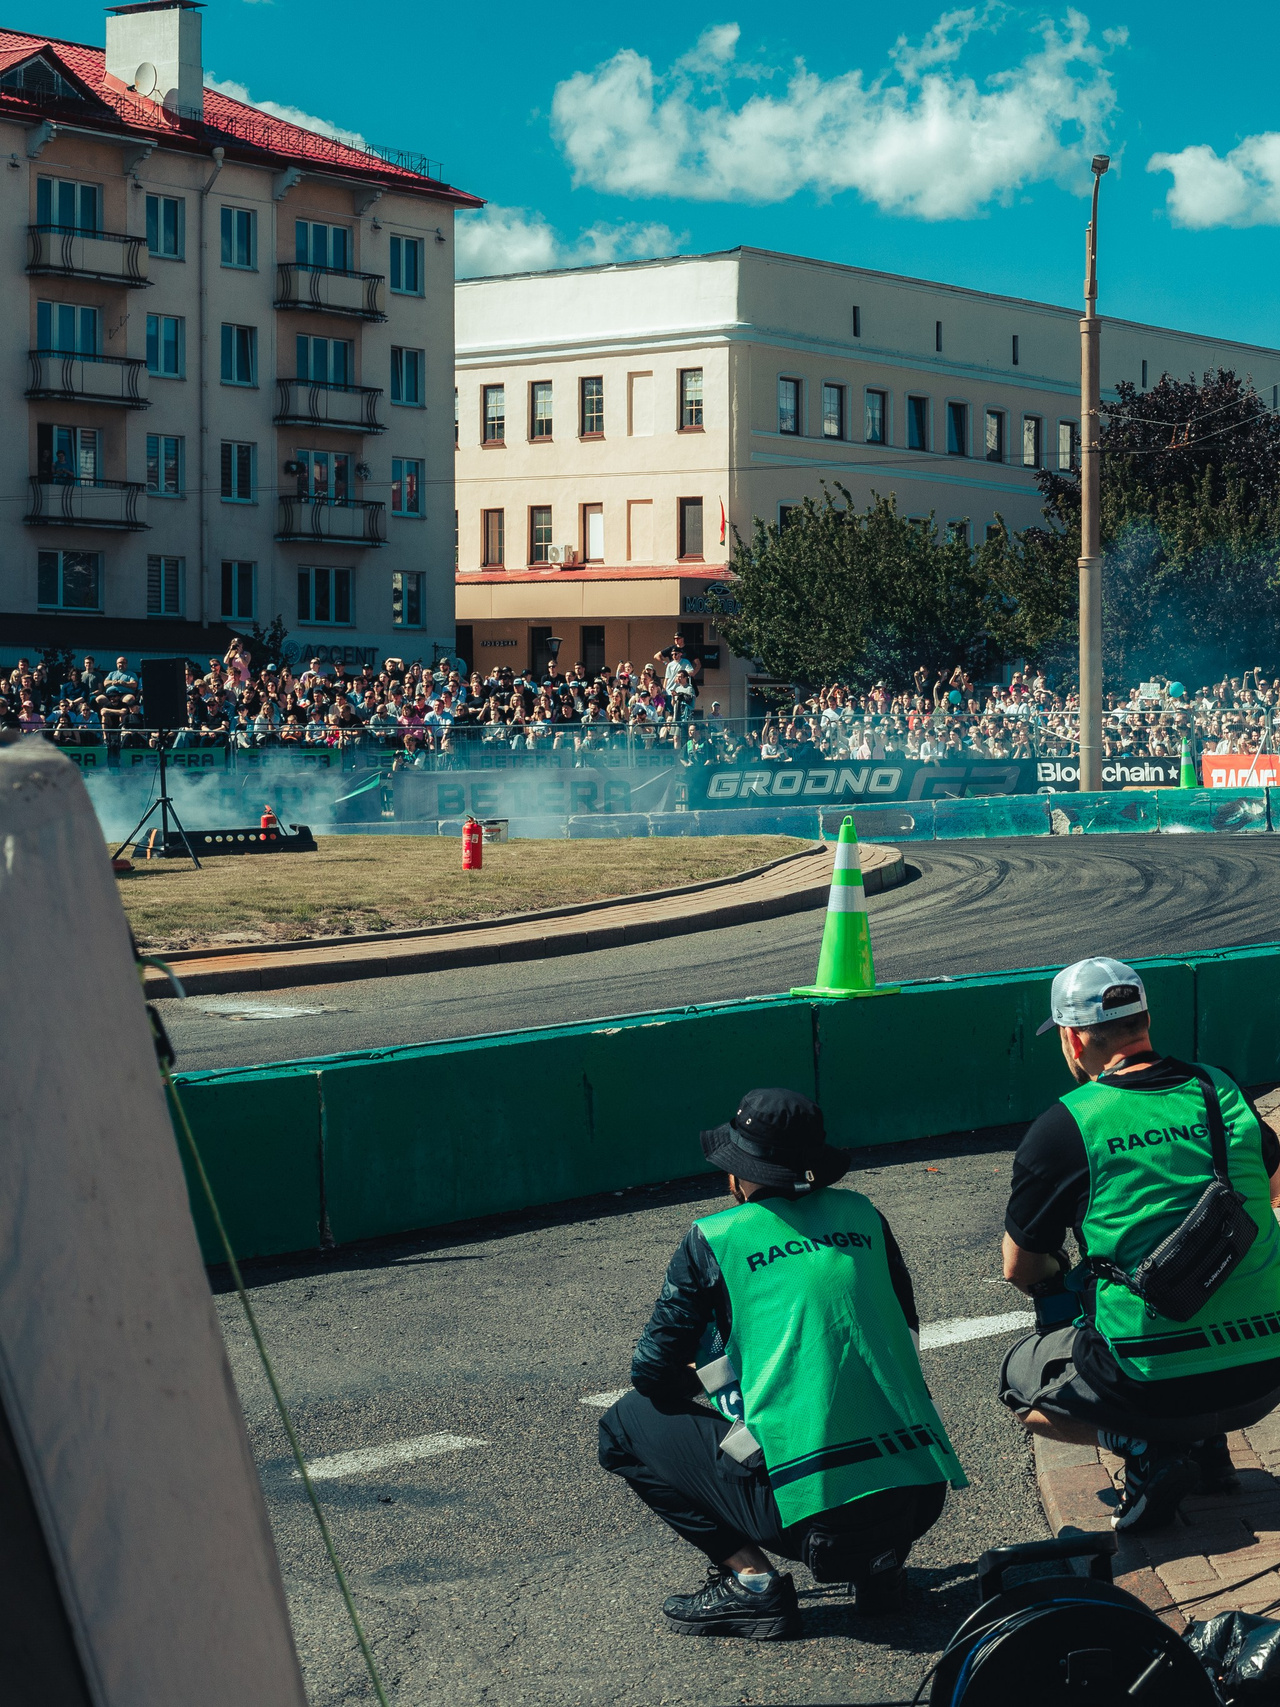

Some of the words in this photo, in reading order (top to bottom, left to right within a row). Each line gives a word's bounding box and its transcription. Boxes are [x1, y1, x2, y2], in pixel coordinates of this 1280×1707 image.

[301, 643, 379, 665] ACCENT
[481, 755, 561, 768] BETERA
[1037, 762, 1165, 782] Blochain
[437, 781, 632, 815] BETERA
[706, 767, 903, 800] GRODNO
[1107, 1121, 1235, 1155] RACINGY
[746, 1232, 872, 1272] RACINGBY
